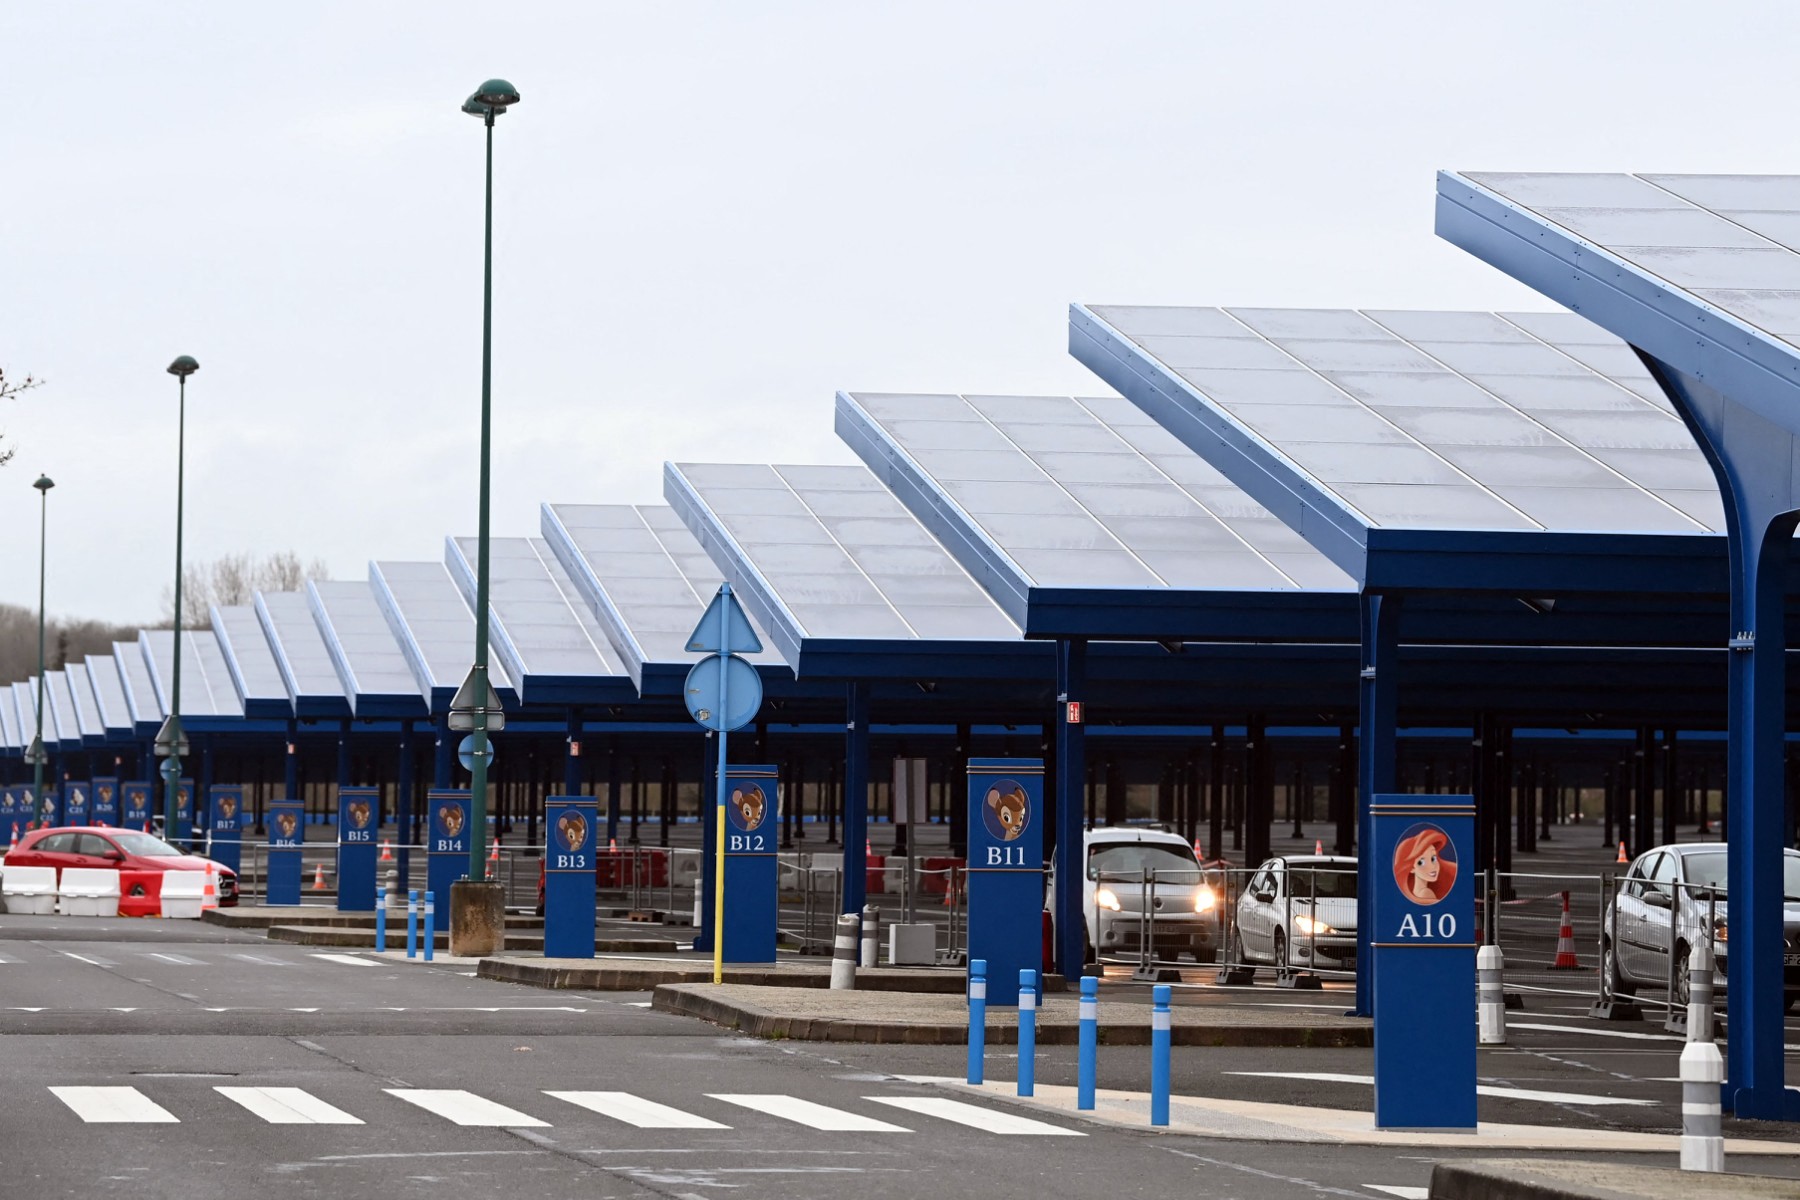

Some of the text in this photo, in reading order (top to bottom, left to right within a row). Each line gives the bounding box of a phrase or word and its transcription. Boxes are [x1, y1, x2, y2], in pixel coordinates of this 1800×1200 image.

[69, 806, 83, 814] C21
[96, 803, 113, 811] B20
[217, 821, 235, 829] B17
[348, 831, 369, 841] B15
[276, 839, 295, 848] B16
[438, 840, 462, 851] B14
[730, 835, 765, 851] B12
[986, 846, 1026, 866] B11
[557, 855, 586, 868] B13
[1396, 913, 1457, 938] A10
